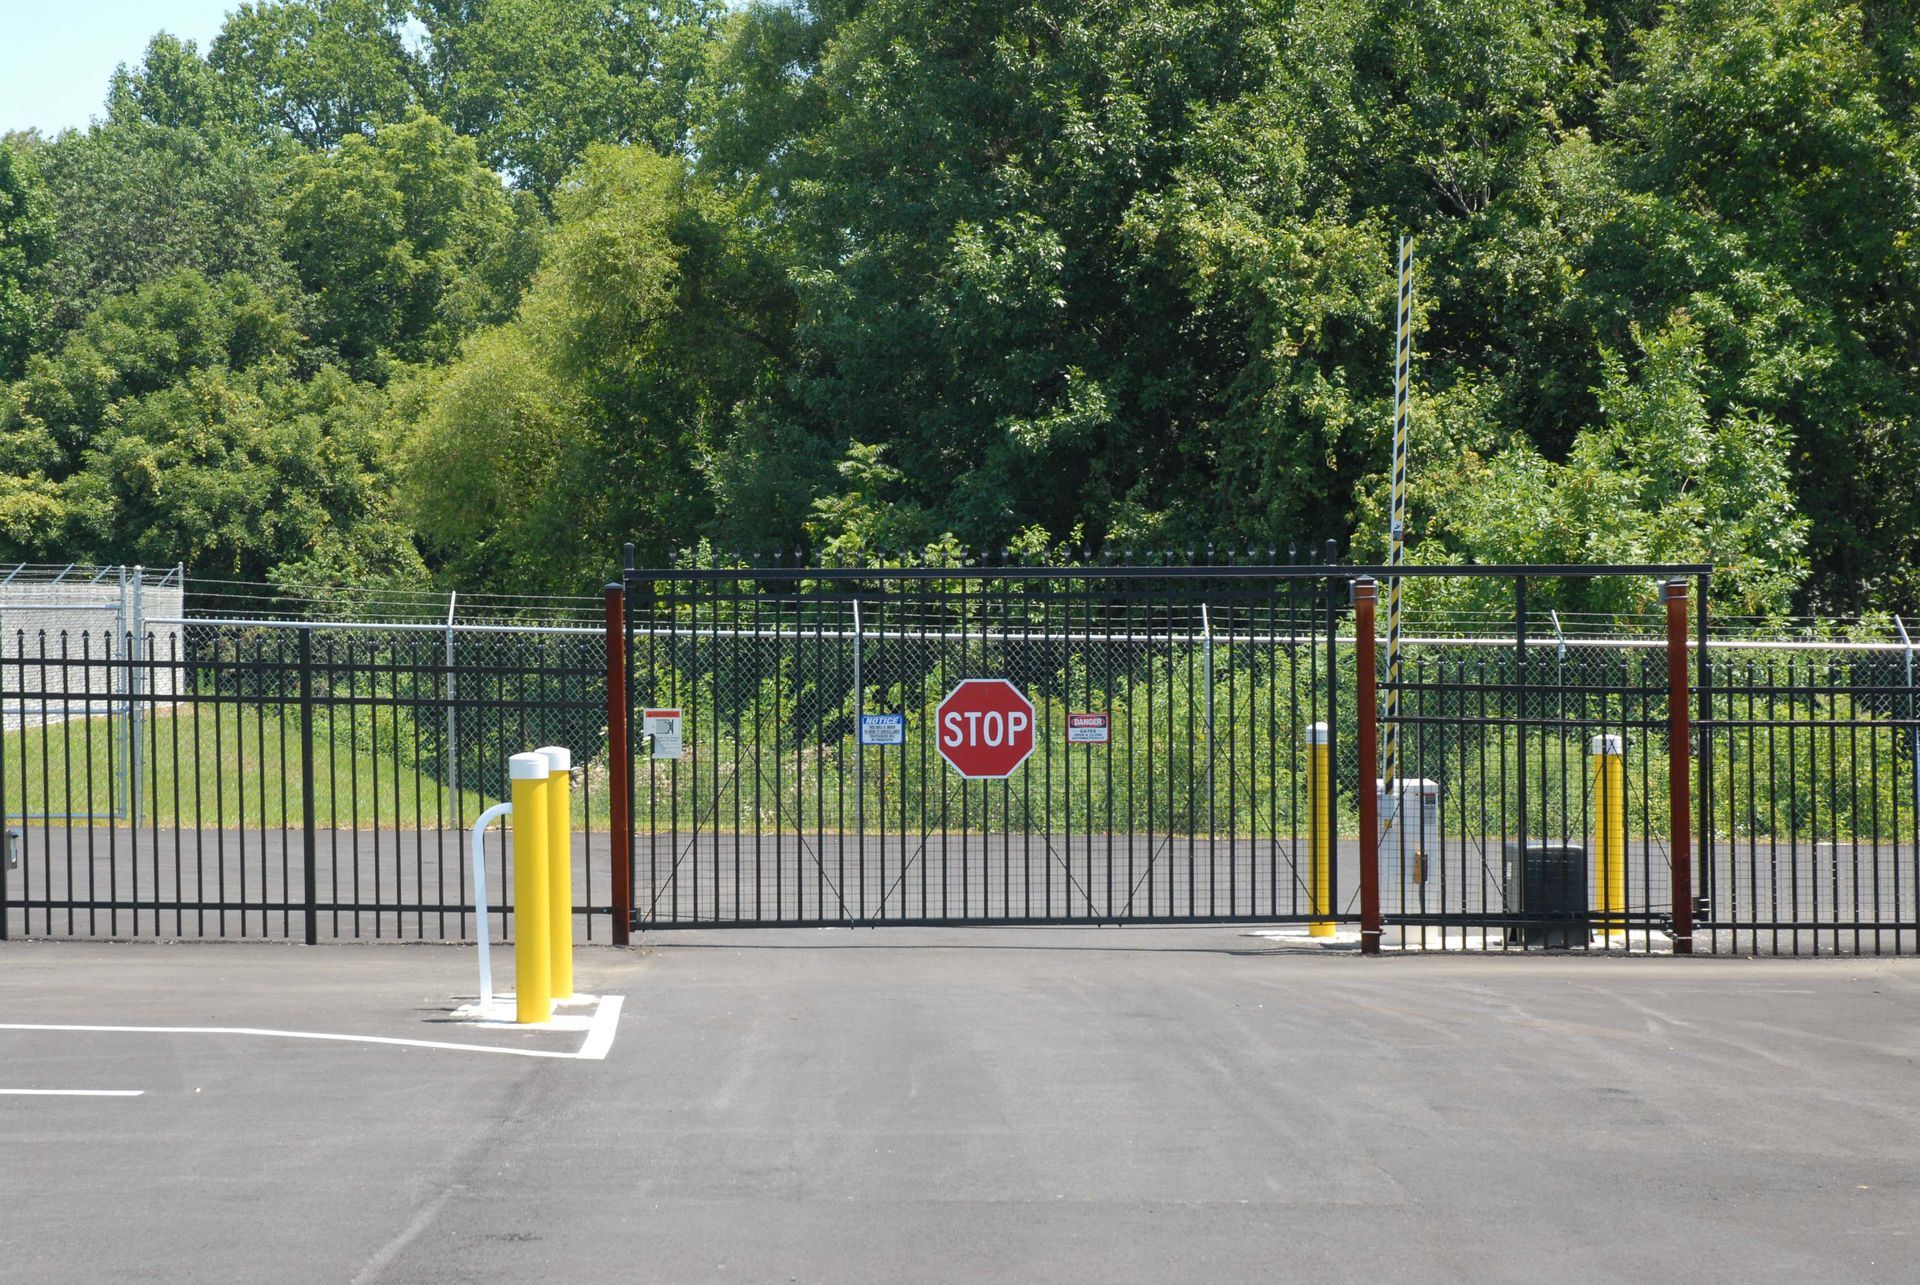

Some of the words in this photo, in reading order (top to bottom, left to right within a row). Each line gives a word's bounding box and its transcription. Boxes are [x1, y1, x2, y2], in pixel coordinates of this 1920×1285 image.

[865, 716, 898, 724] NOTICE
[1074, 718, 1102, 726] DANGER
[944, 711, 1028, 747] STOP
